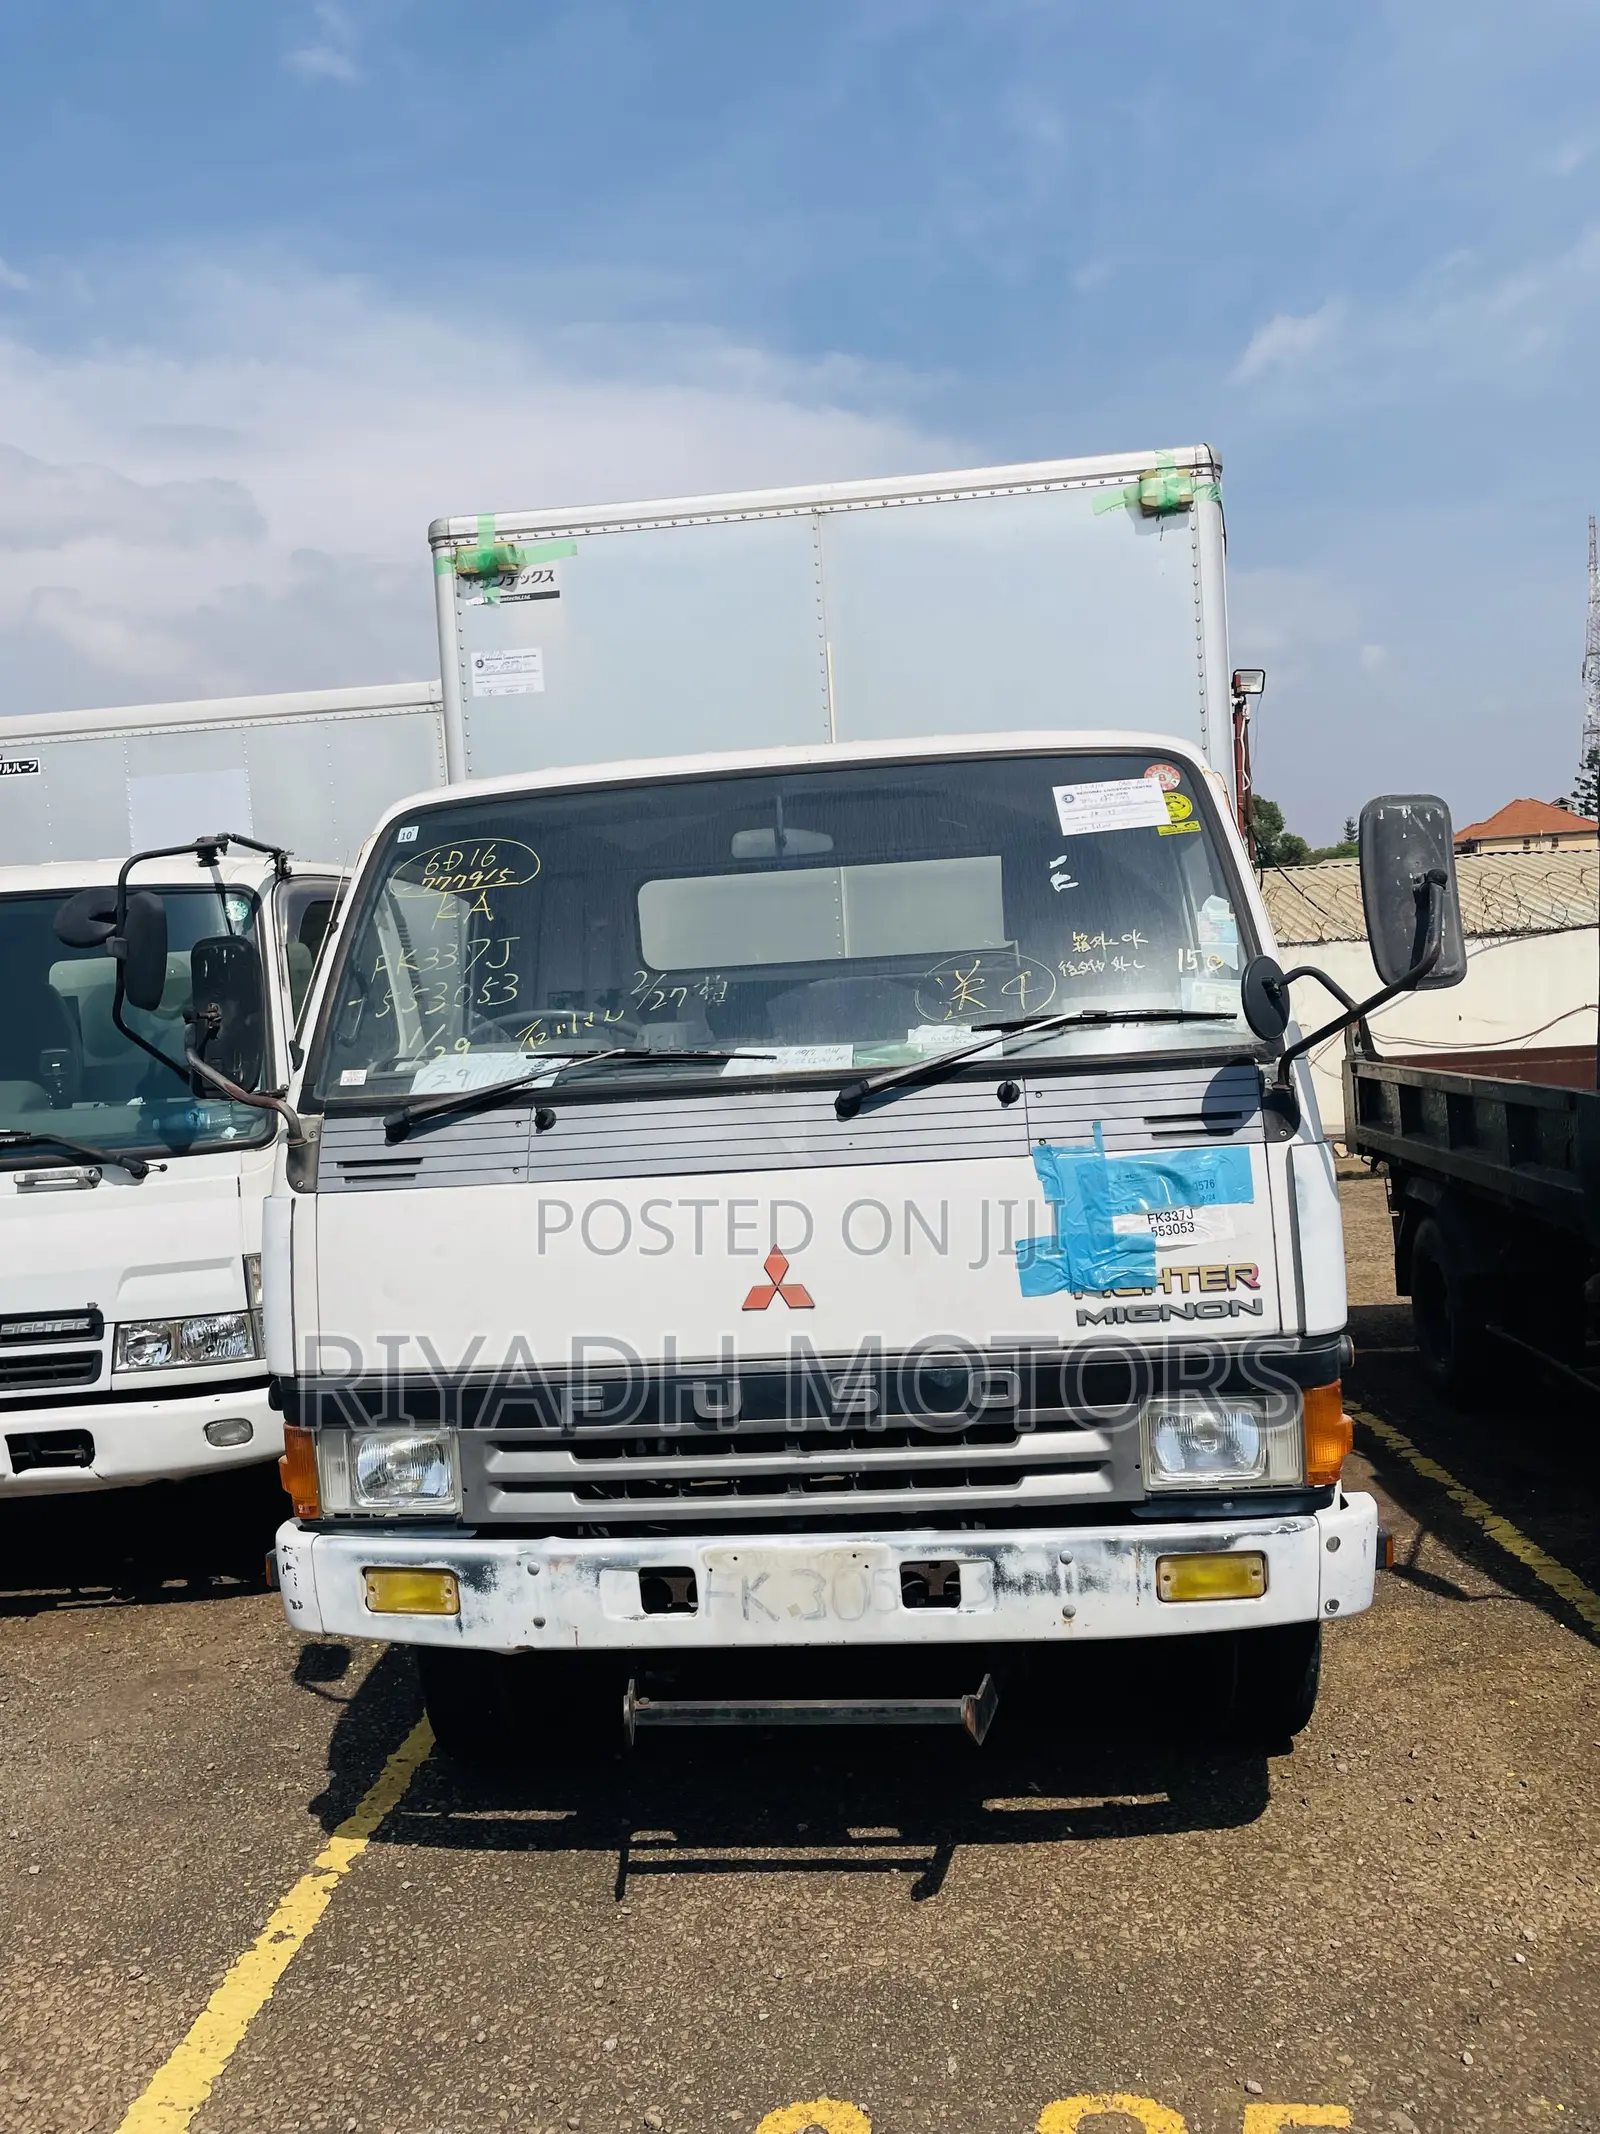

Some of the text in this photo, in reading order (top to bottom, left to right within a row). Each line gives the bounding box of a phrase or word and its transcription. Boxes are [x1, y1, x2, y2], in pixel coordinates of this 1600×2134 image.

[424, 844, 497, 876] 6D16
[371, 937, 520, 983] FK337J
[1147, 1208, 1194, 1225] FK337J
[1151, 1222, 1195, 1238] 553053
[1076, 1298, 1263, 1326] MIGNON
[560, 1370, 1022, 1430] FUSO
